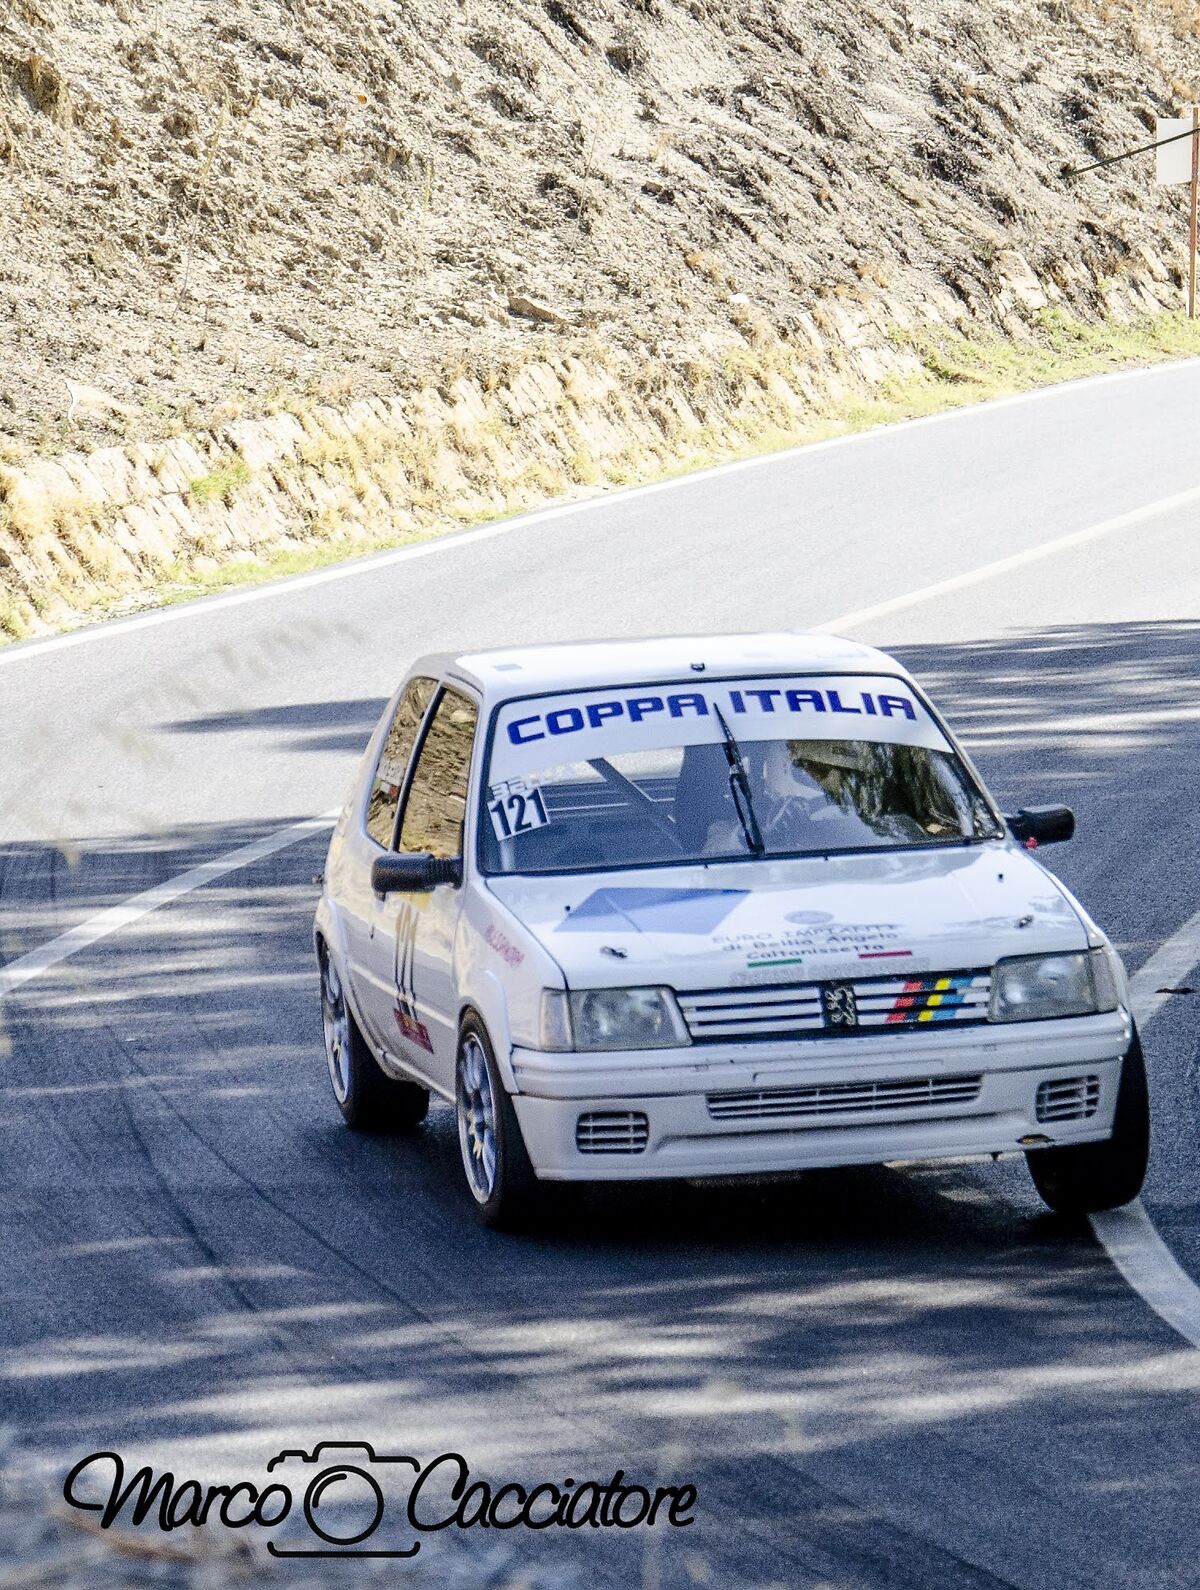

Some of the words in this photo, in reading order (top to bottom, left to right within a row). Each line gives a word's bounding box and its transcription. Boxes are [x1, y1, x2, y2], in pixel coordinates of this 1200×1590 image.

[506, 693, 710, 746] COPPA
[728, 688, 918, 722] ITALIA
[490, 788, 549, 837] 121
[722, 942, 742, 952] di
